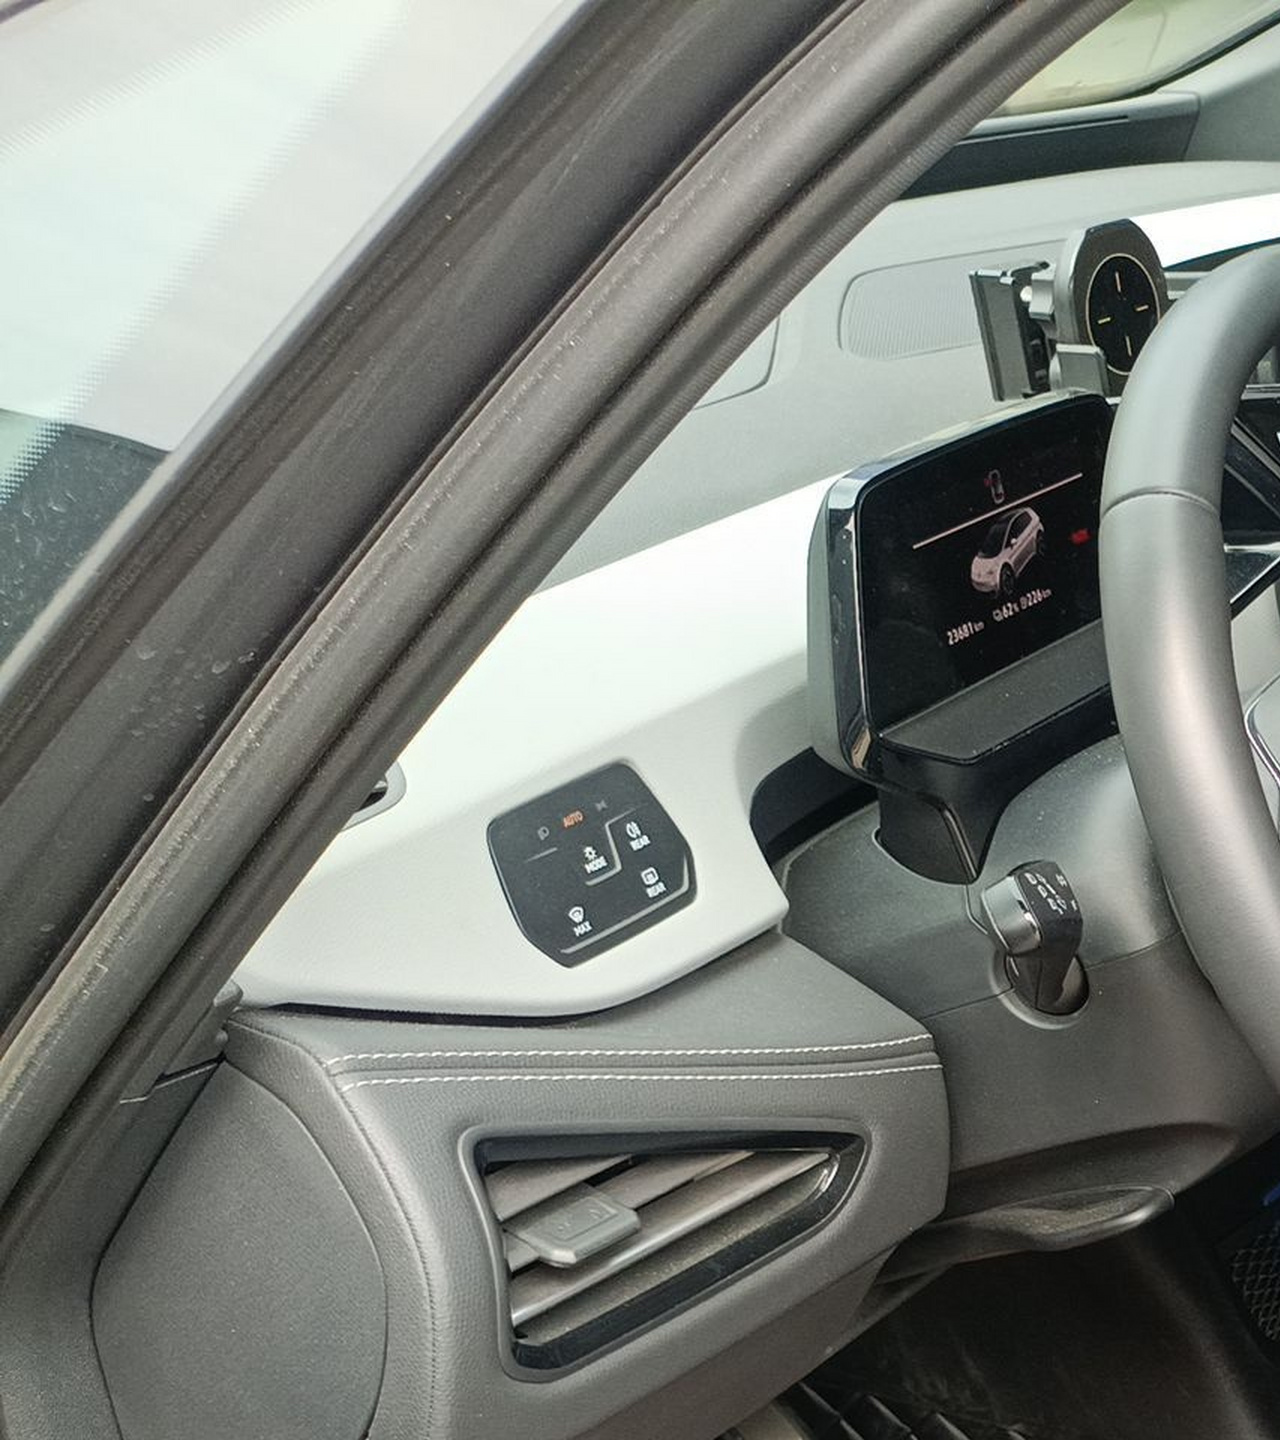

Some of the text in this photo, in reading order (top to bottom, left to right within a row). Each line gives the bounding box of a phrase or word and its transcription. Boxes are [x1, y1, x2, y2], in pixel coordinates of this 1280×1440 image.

[563, 811, 584, 829] AUTO
[629, 834, 651, 851] REAR
[585, 855, 608, 874] MODE
[646, 882, 666, 898] REAR
[573, 922, 592, 937] MAX
